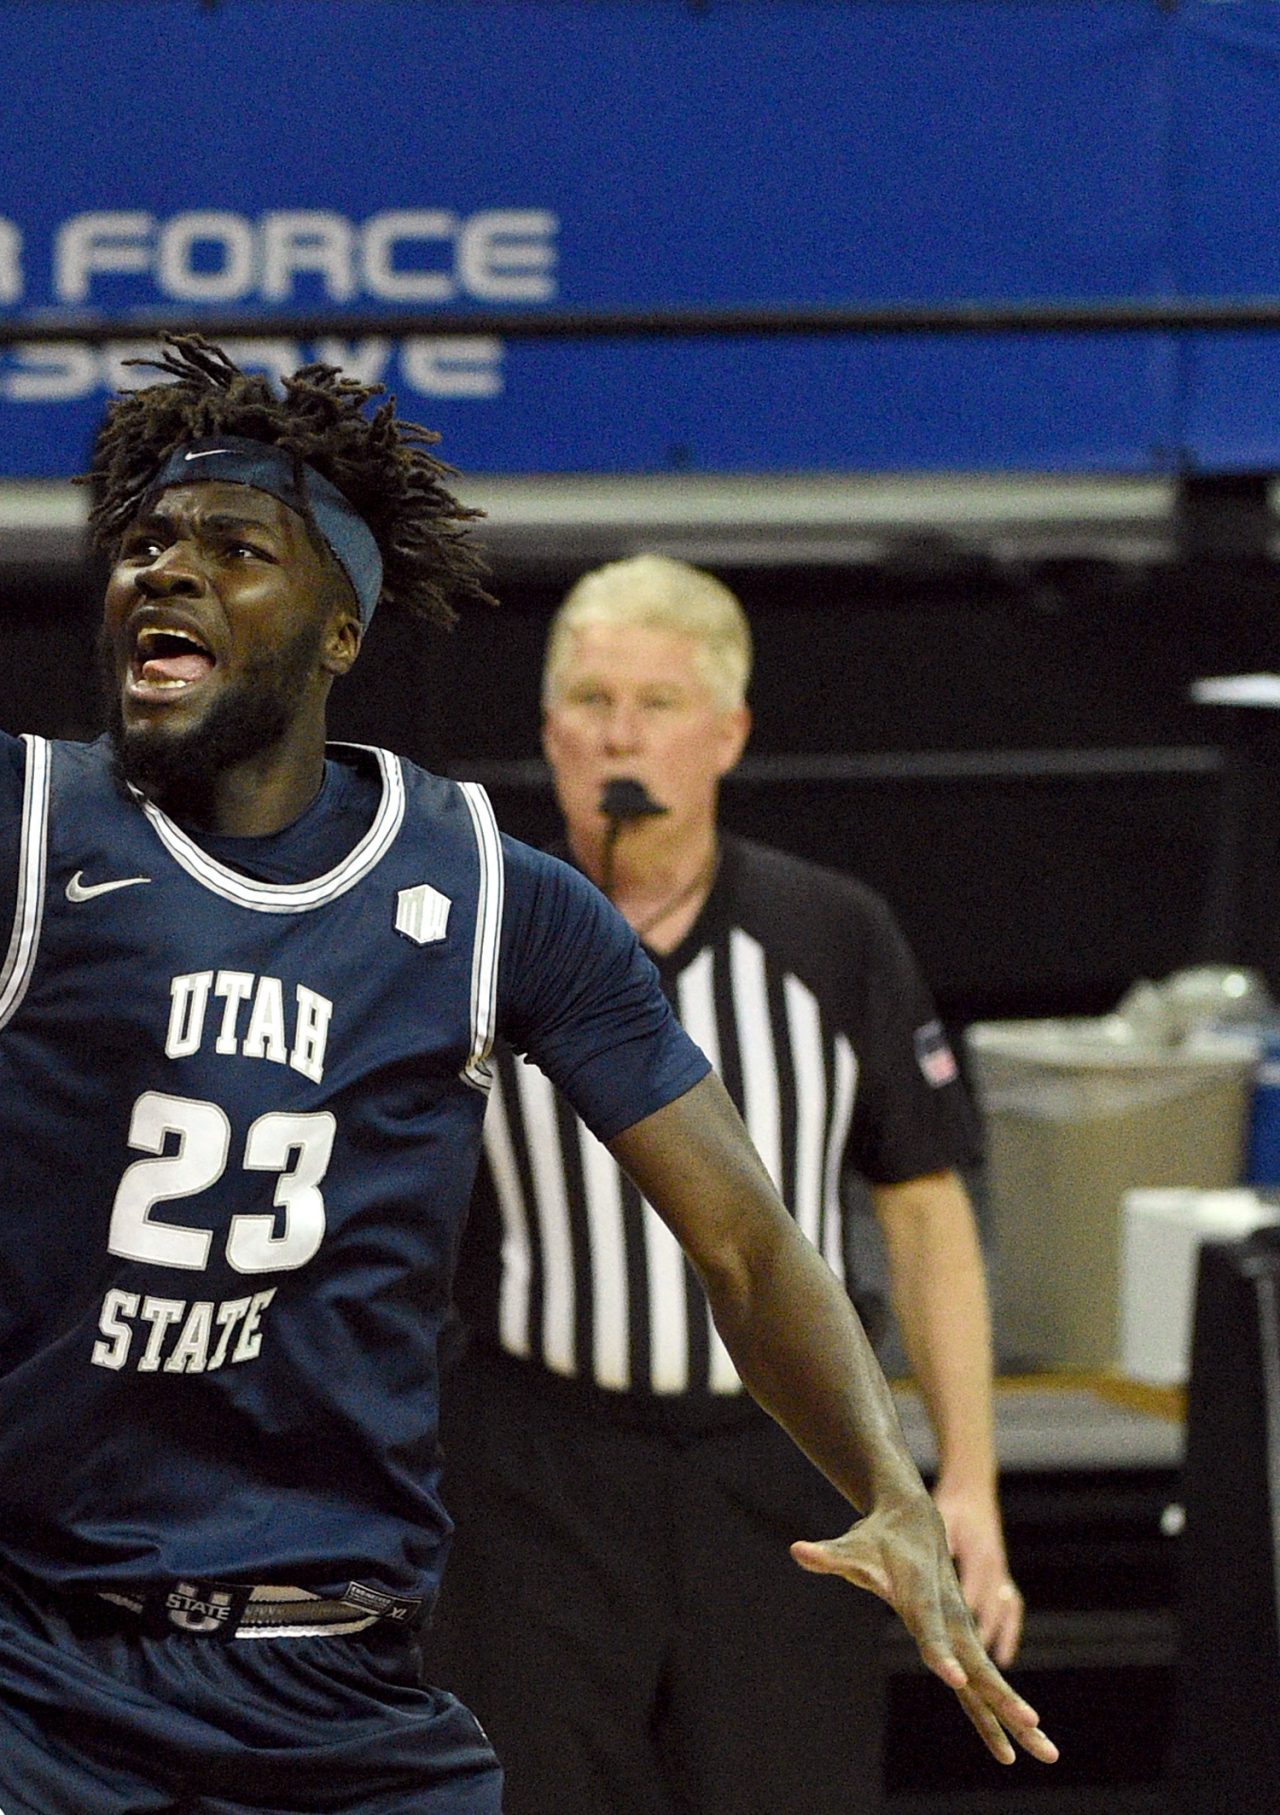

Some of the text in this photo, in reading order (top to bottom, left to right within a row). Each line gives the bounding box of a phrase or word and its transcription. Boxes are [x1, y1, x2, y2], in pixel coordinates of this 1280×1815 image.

[54, 210, 558, 304] FORCE
[165, 970, 332, 1084] UTAH
[107, 1090, 337, 1274] 23
[91, 1287, 278, 1374] STATE
[165, 1593, 231, 1620] STATE
[385, 1606, 408, 1620] XL
